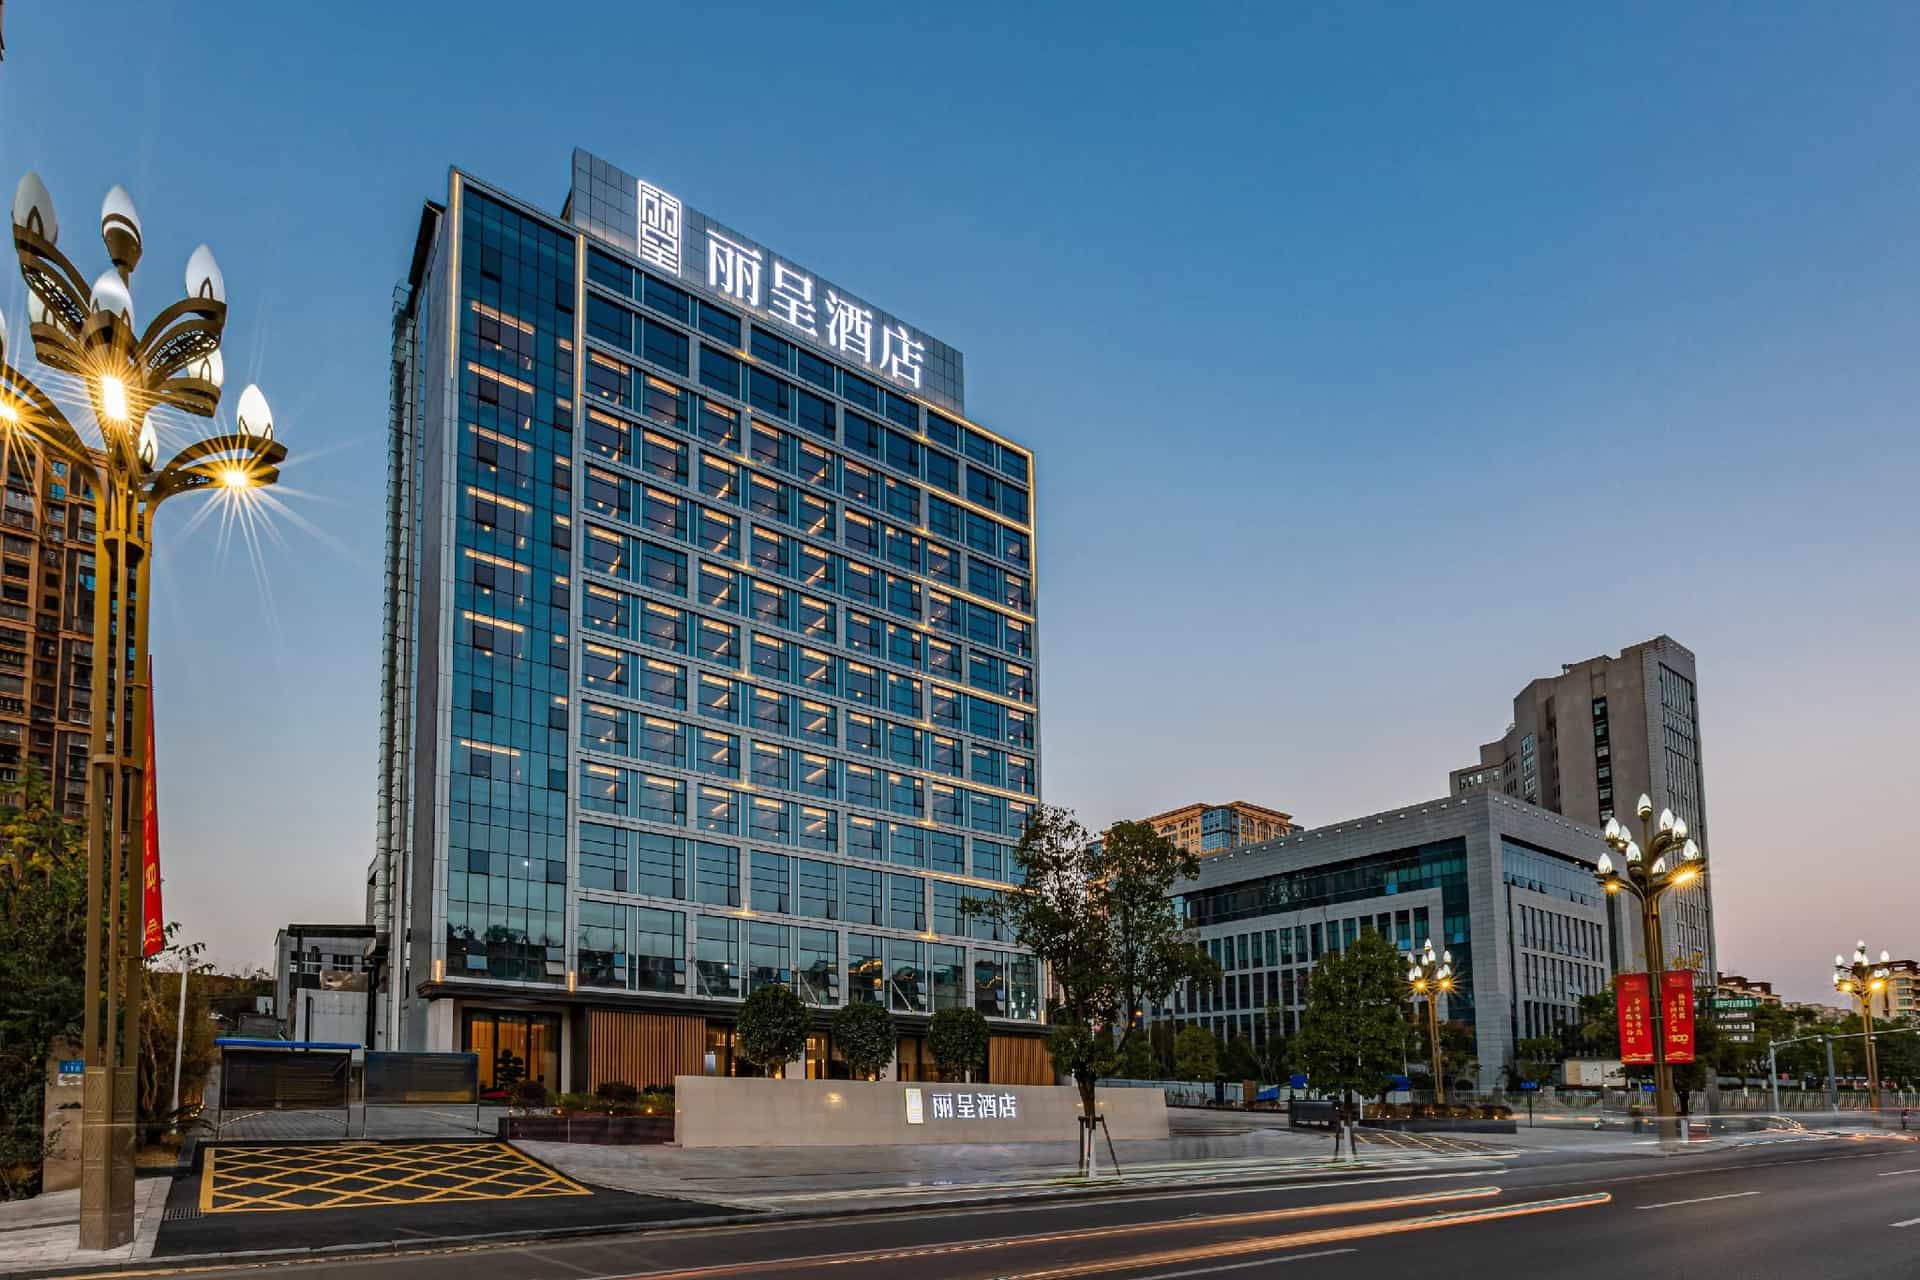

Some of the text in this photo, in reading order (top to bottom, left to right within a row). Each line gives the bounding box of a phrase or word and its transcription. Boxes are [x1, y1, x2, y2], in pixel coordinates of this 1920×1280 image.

[706, 229, 925, 389] 丽呈酒店
[932, 1093, 1017, 1119] 丽呈酒店
